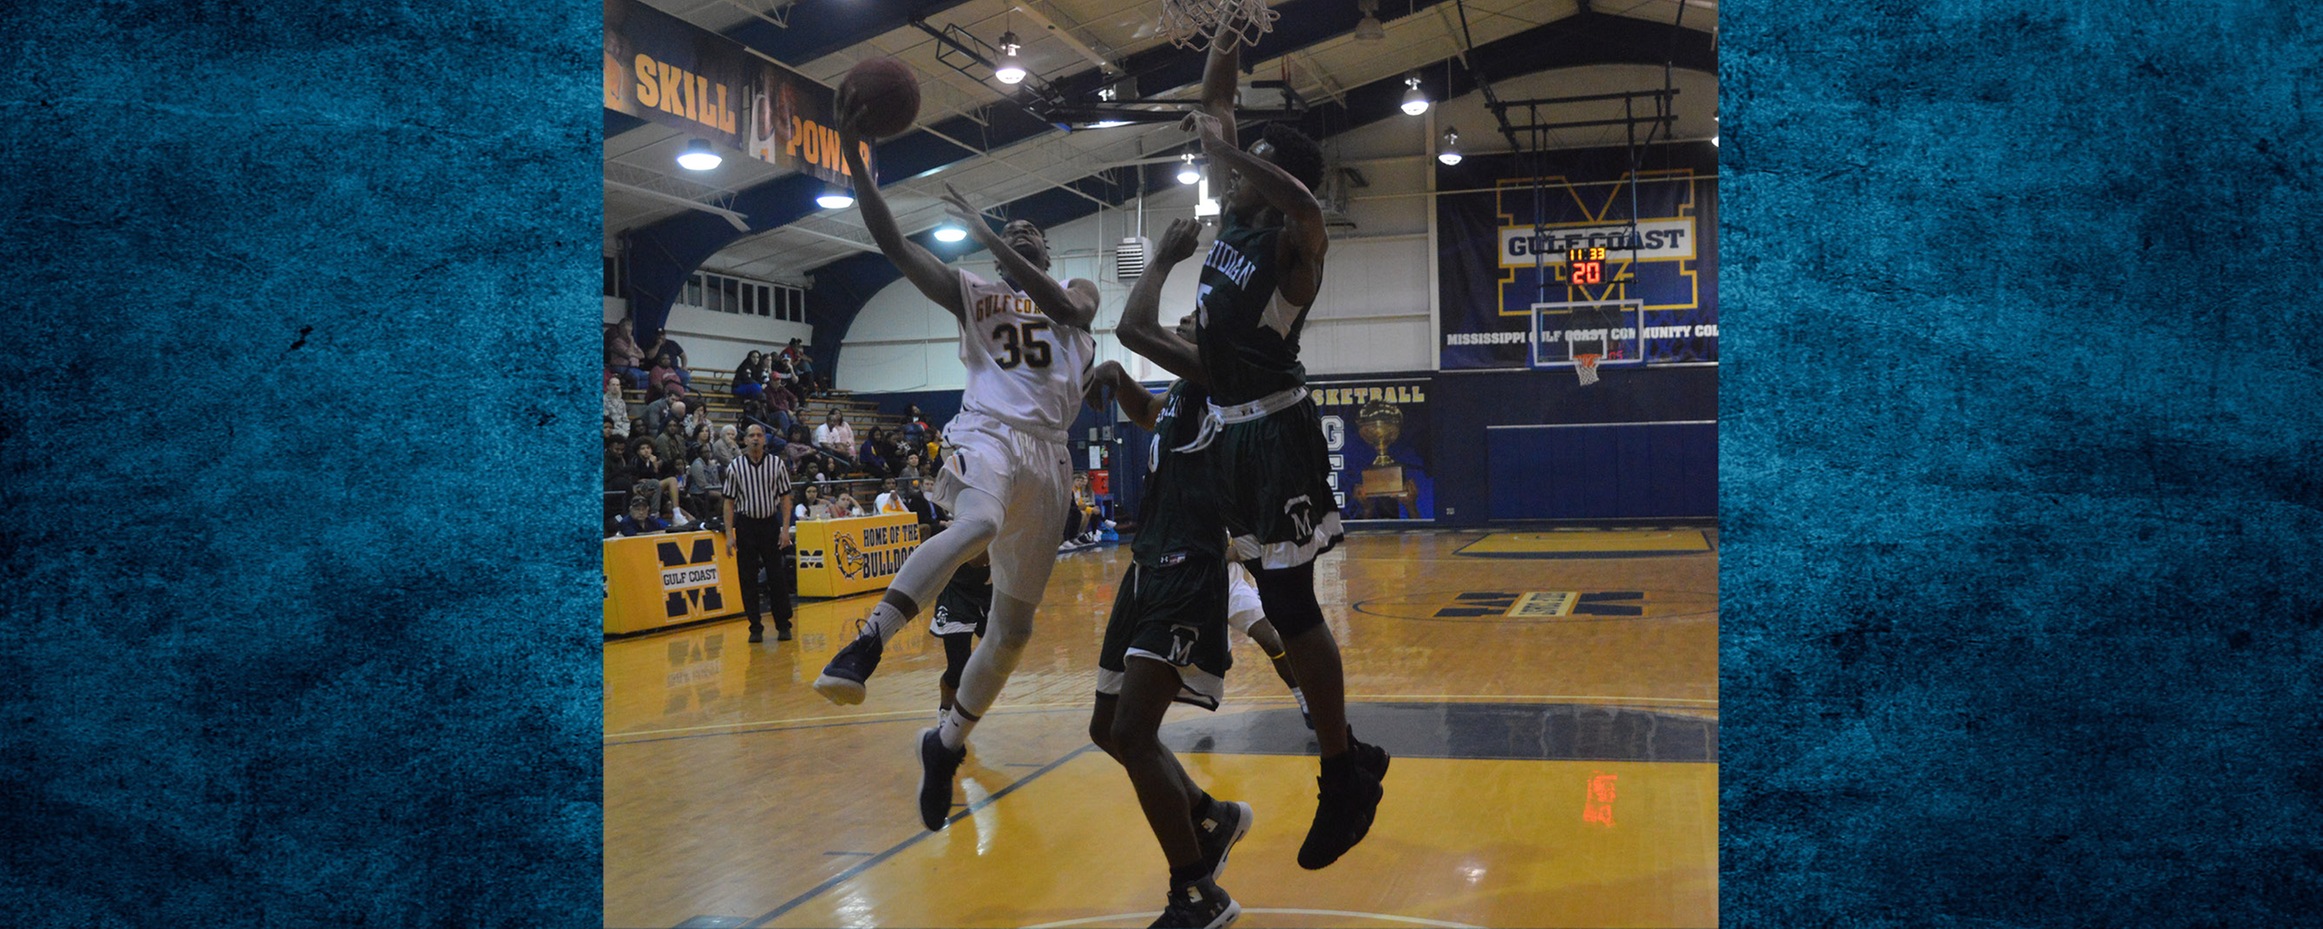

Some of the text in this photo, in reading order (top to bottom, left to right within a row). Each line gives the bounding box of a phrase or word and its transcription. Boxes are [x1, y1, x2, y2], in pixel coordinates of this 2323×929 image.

[634, 53, 737, 135] SKILL
[1508, 229, 1685, 256] GULF COAST
[1572, 262, 1600, 285] 20
[976, 294, 1012, 322] GULF
[992, 322, 1052, 370] 35
[1446, 331, 1526, 346] MISSISSIPPI
[1564, 328, 1608, 342] COAST
[863, 523, 919, 547] HOME OF THE
[862, 544, 919, 579] BULLDO
[663, 568, 717, 586] GULF COAST
